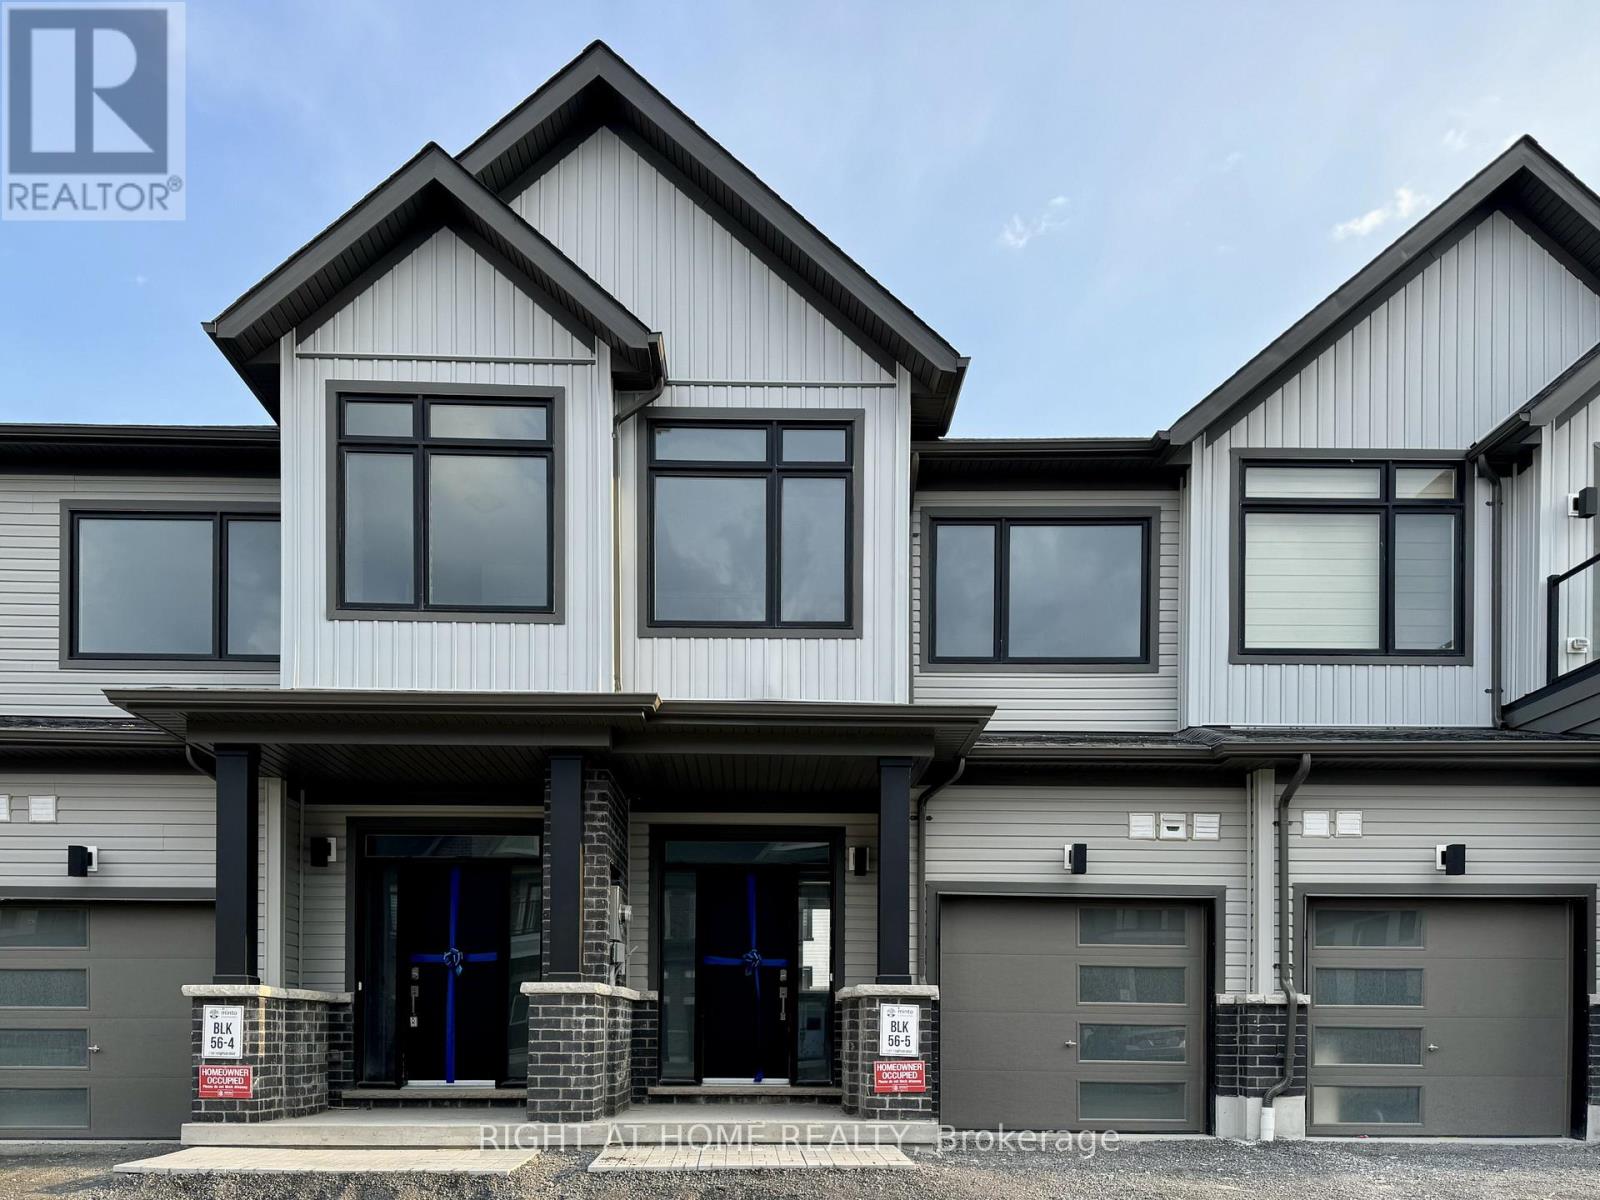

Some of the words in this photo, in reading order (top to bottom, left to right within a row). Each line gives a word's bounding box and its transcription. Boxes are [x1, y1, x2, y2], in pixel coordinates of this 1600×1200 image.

[213, 1022, 232, 1035] BLK
[891, 1020, 909, 1033] BLK
[210, 1036, 235, 1049] 56-4
[888, 1034, 911, 1047] 56-5
[201, 1068, 249, 1077] HOMEOWNER
[876, 1063, 923, 1072] HOMEOWNER
[207, 1076, 244, 1085] OCCUPIED
[882, 1071, 918, 1080] OCCUPIED
